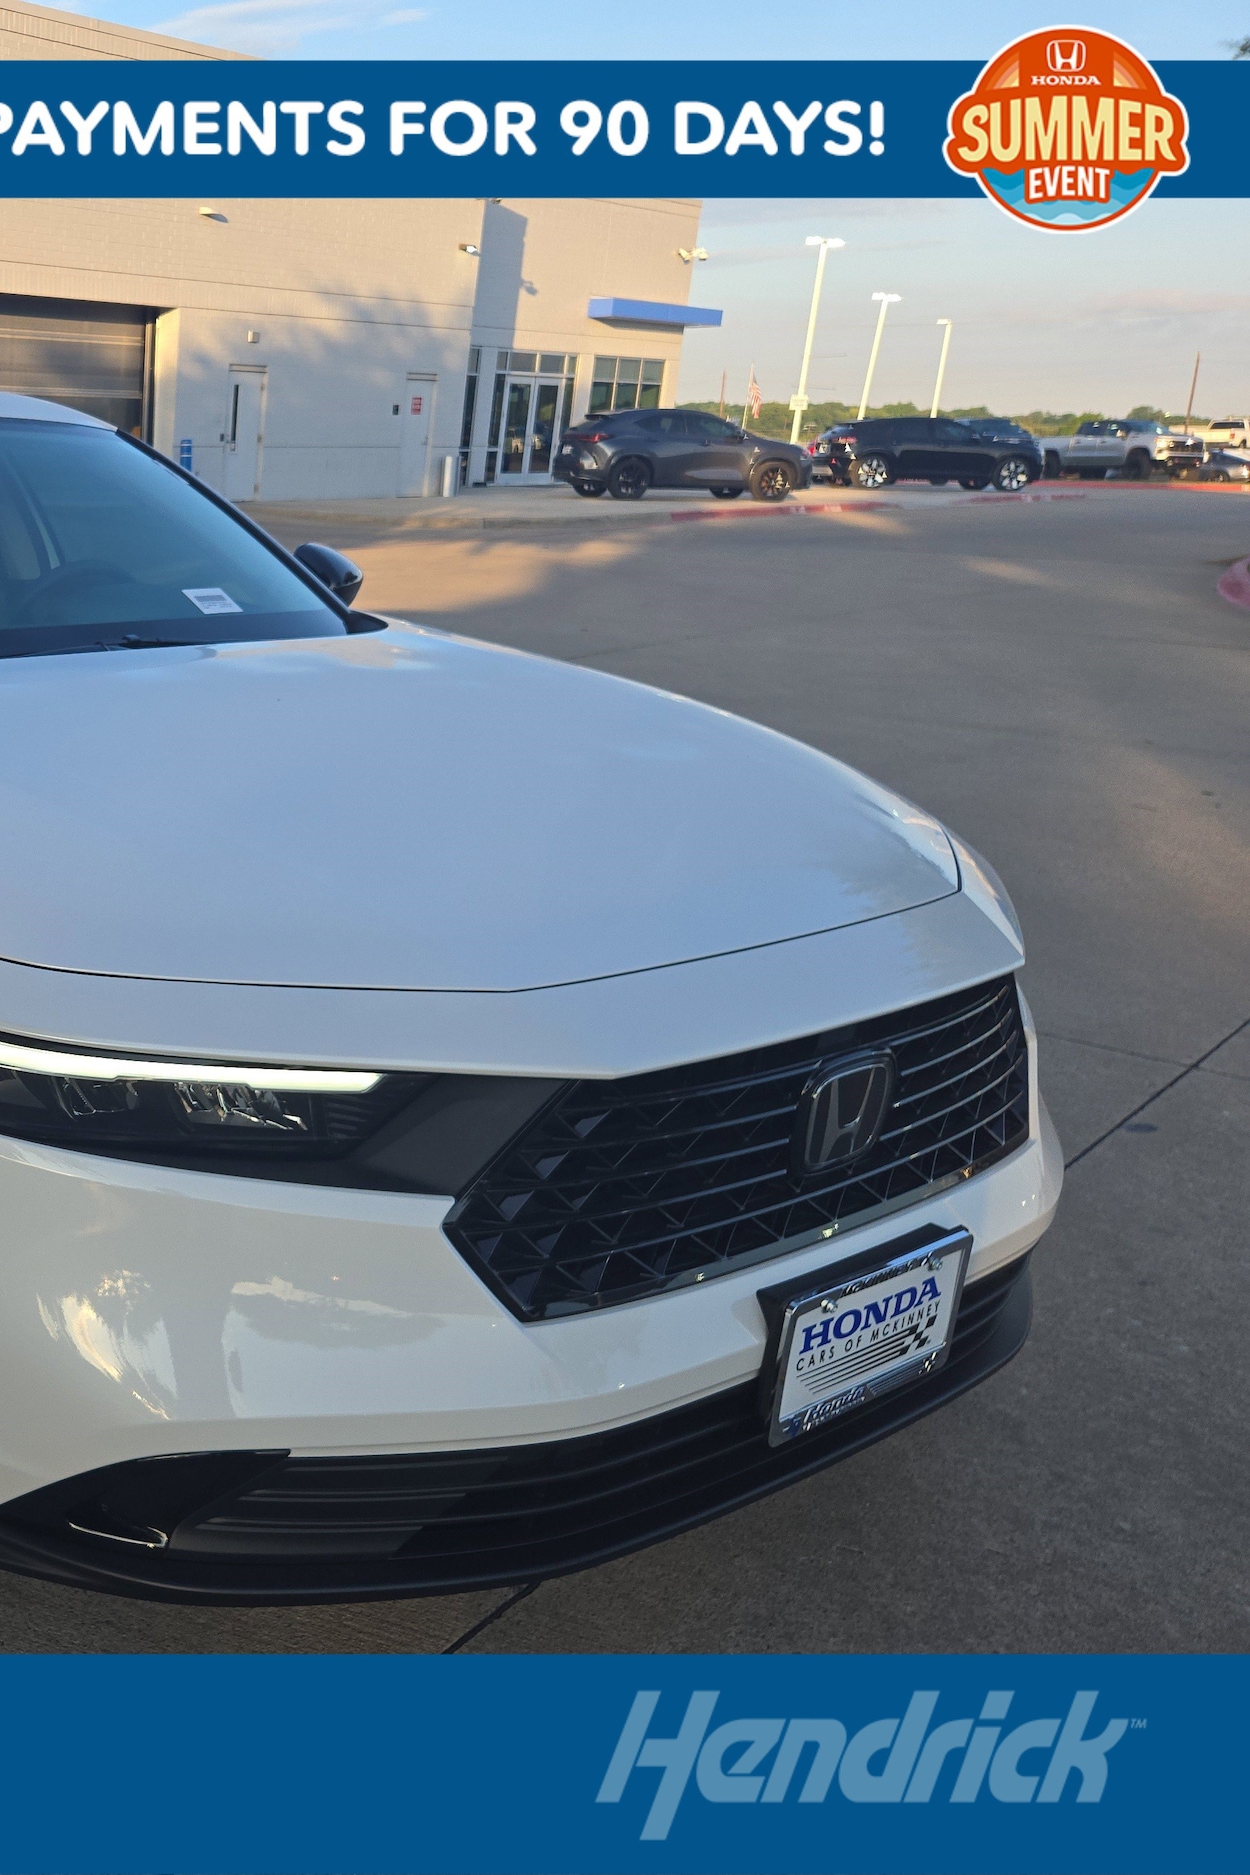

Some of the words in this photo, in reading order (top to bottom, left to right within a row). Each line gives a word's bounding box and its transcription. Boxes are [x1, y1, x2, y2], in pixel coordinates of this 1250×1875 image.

[796, 1346, 835, 1371] CARS
[844, 1335, 862, 1353] OF
[869, 1300, 941, 1341] MCKINNEY
[799, 1276, 941, 1355] HONDA
